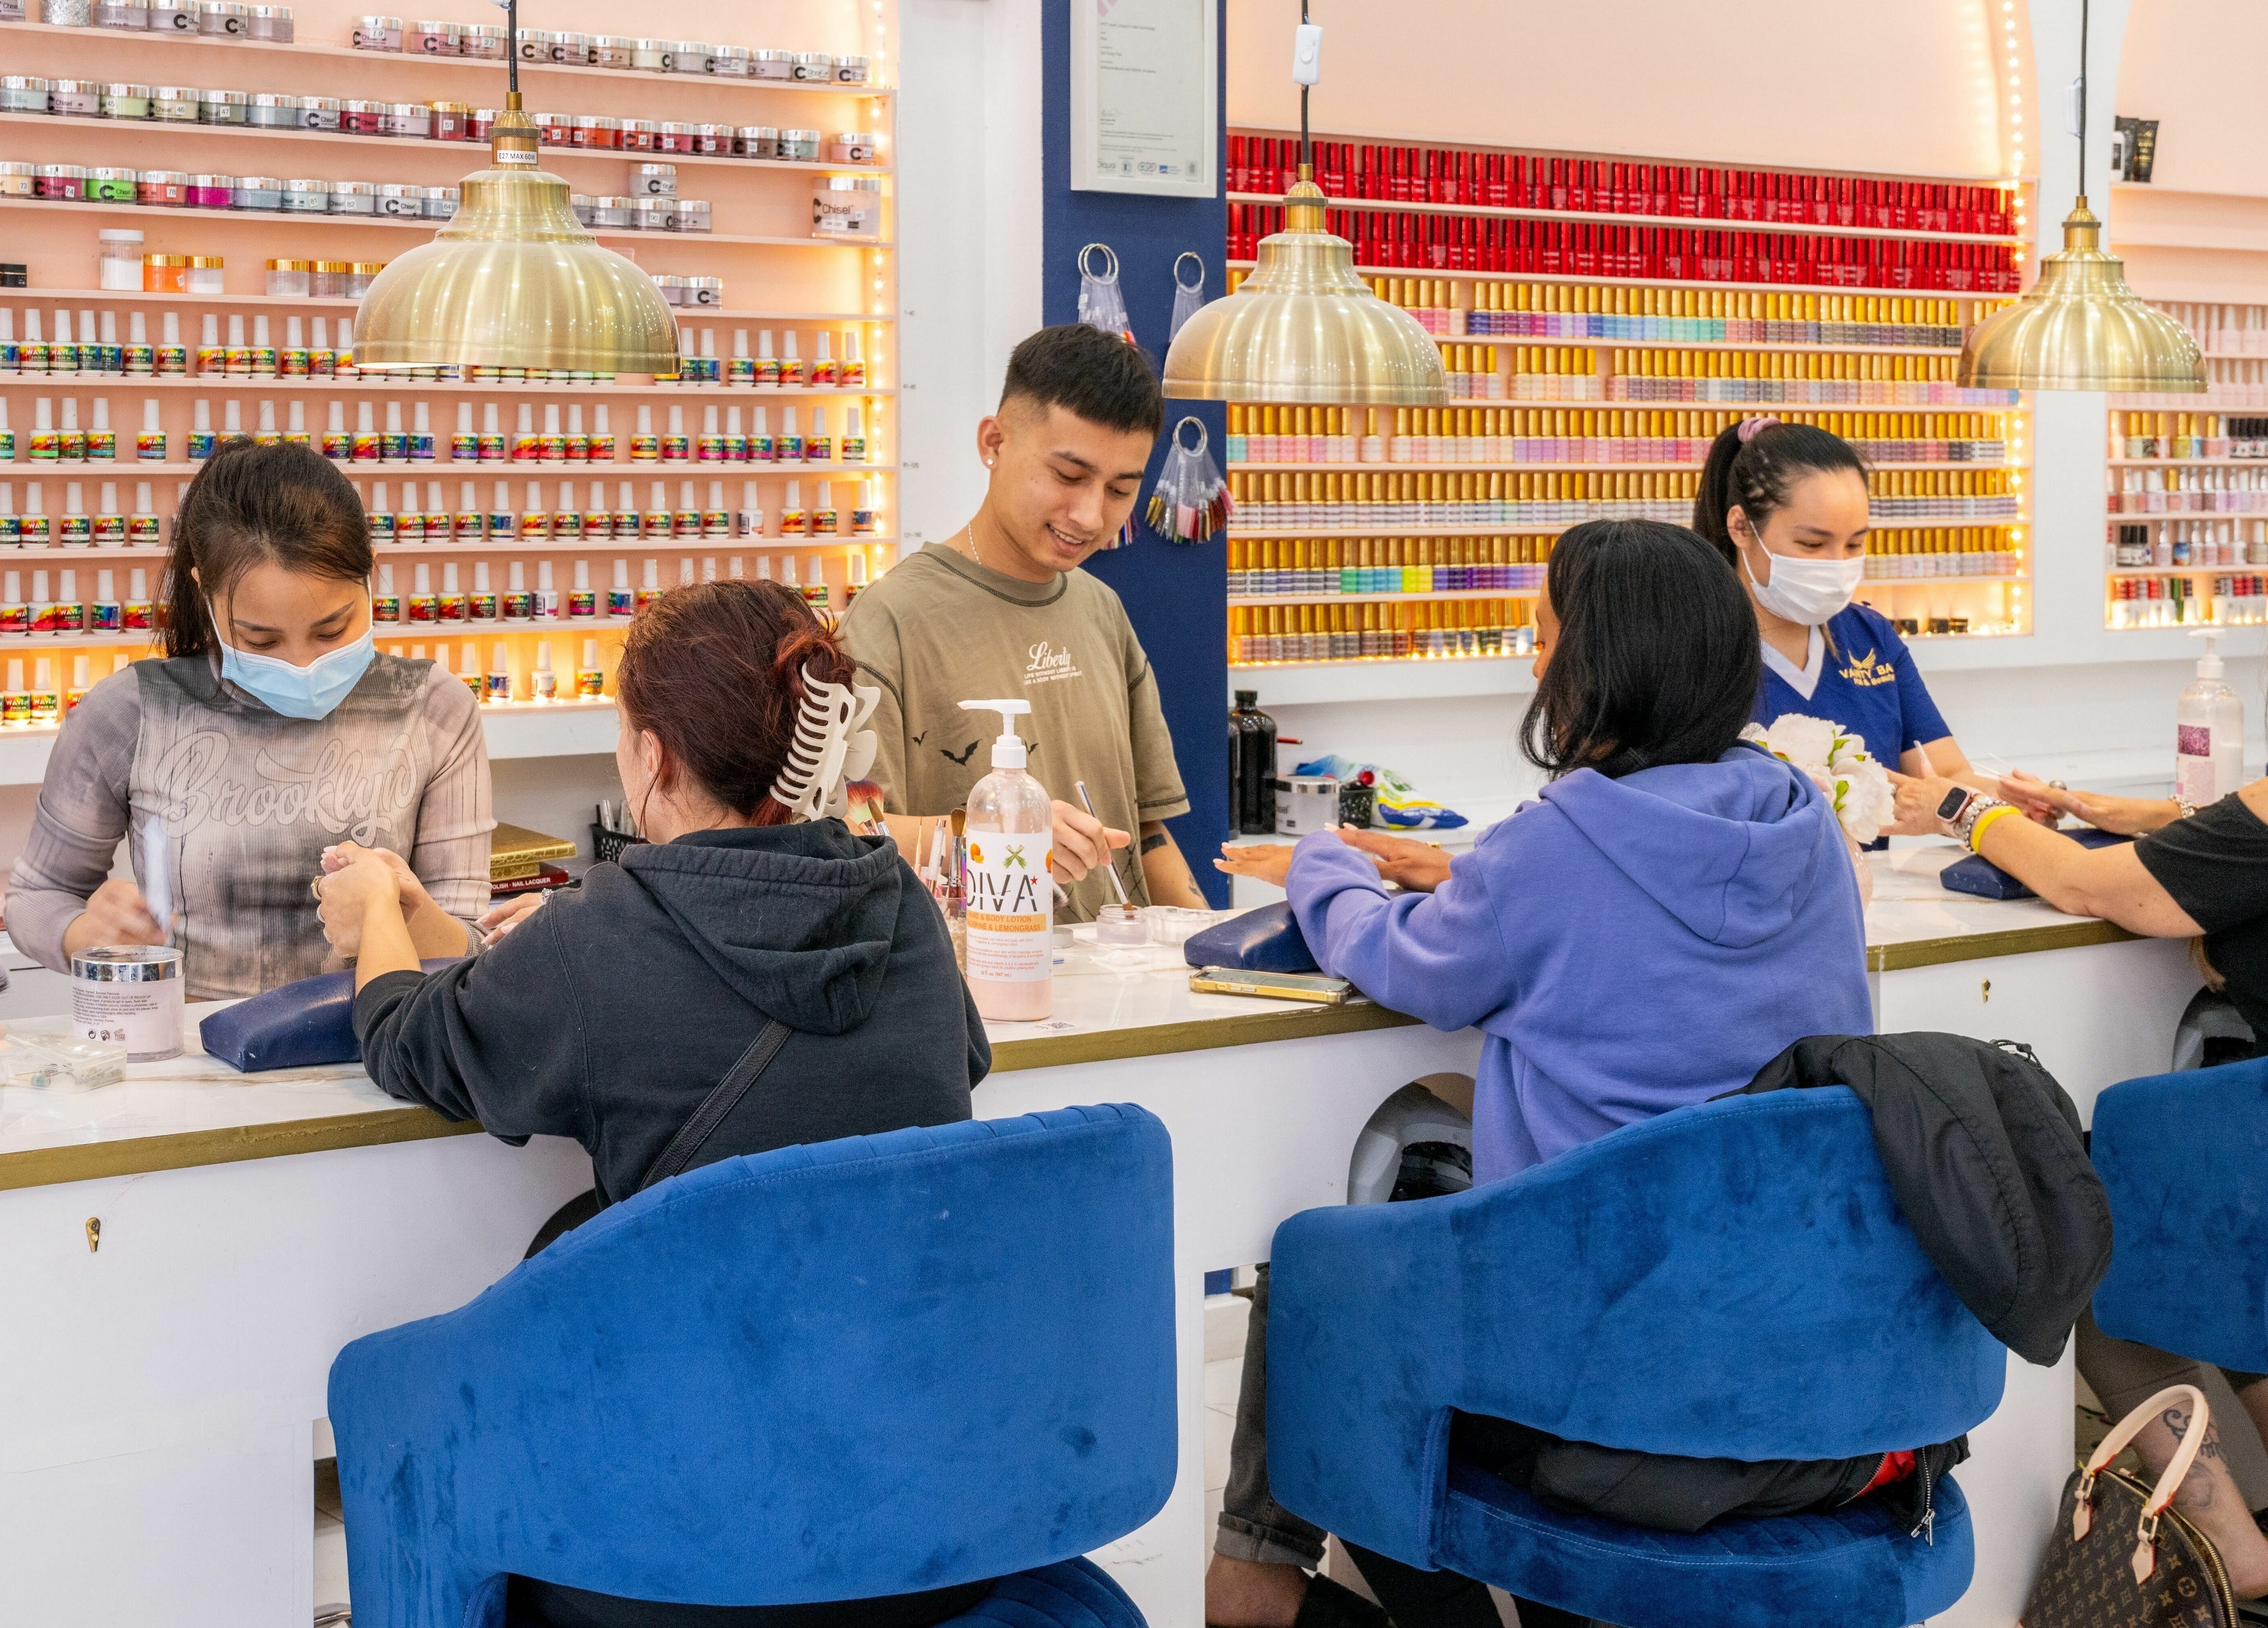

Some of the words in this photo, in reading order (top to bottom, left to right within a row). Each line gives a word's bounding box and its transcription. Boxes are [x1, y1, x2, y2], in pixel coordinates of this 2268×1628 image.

[55, 98, 73, 108] Chisel
[107, 99, 115, 108] 45
[155, 104, 172, 112] Chisel
[400, 202, 416, 210] Chisel
[822, 204, 852, 215] Chisel
[1027, 642, 1071, 671] Liberty
[1035, 669, 1055, 677] WITHOUT
[154, 729, 418, 848] Brooklyn
[525, 877, 551, 886] LACQUER
